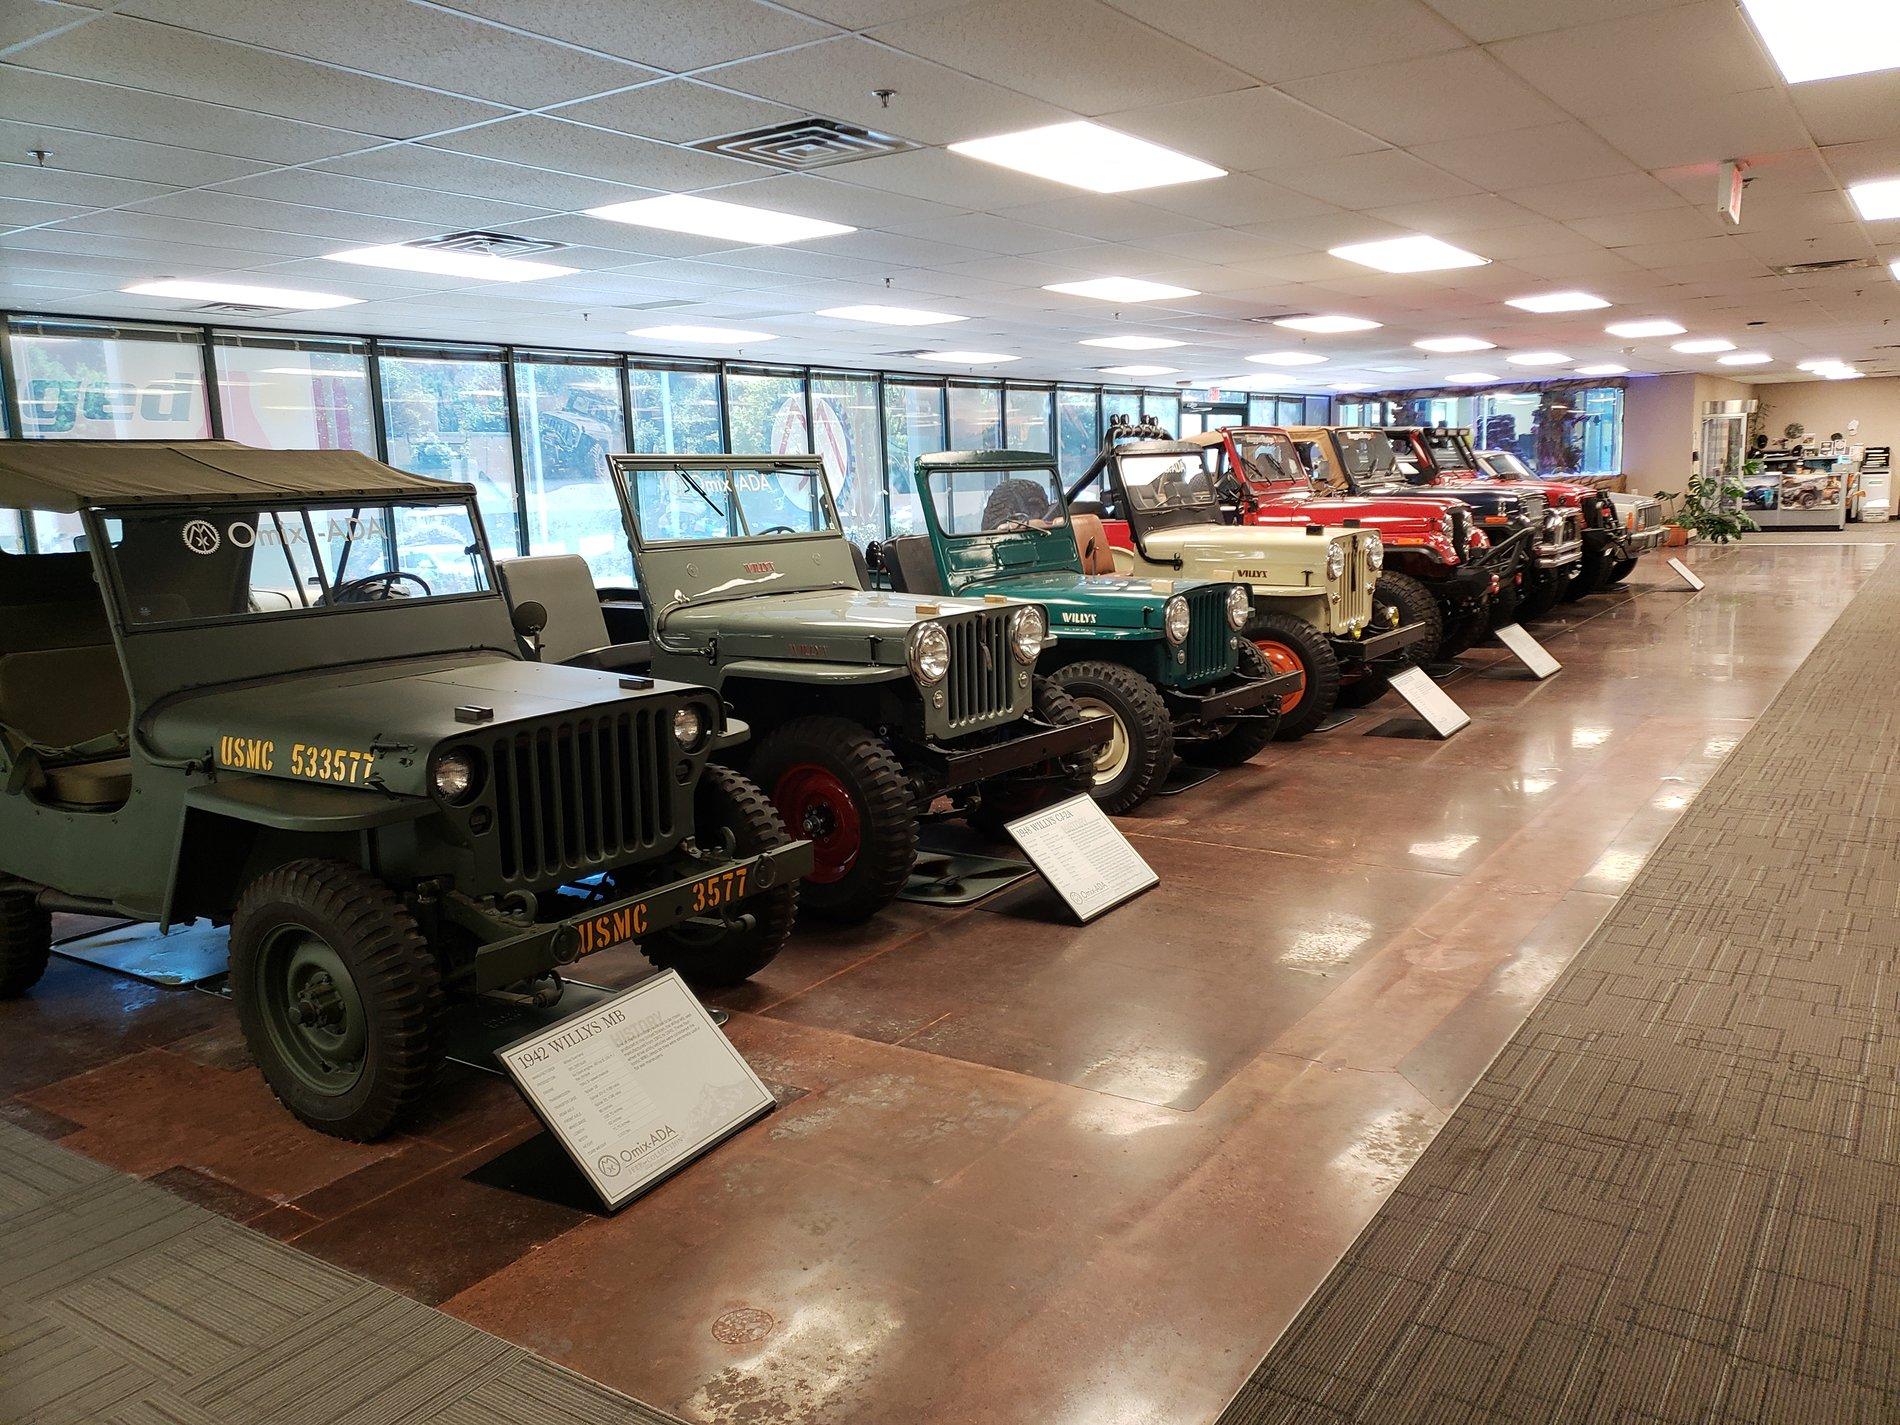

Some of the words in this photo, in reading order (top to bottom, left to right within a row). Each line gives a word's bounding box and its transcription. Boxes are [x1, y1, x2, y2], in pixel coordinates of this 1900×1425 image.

[1062, 612, 1097, 624] WILLYS
[220, 735, 274, 771] USMC
[291, 743, 375, 785] 533577
[1030, 815, 1057, 831] WILLYS
[578, 903, 648, 954] USMC
[692, 868, 748, 912] 3577
[517, 1046, 550, 1069] 1942
[548, 1020, 602, 1053] WILLYS
[600, 1009, 626, 1029] MB
[619, 1125, 676, 1162] Omix-ADA
